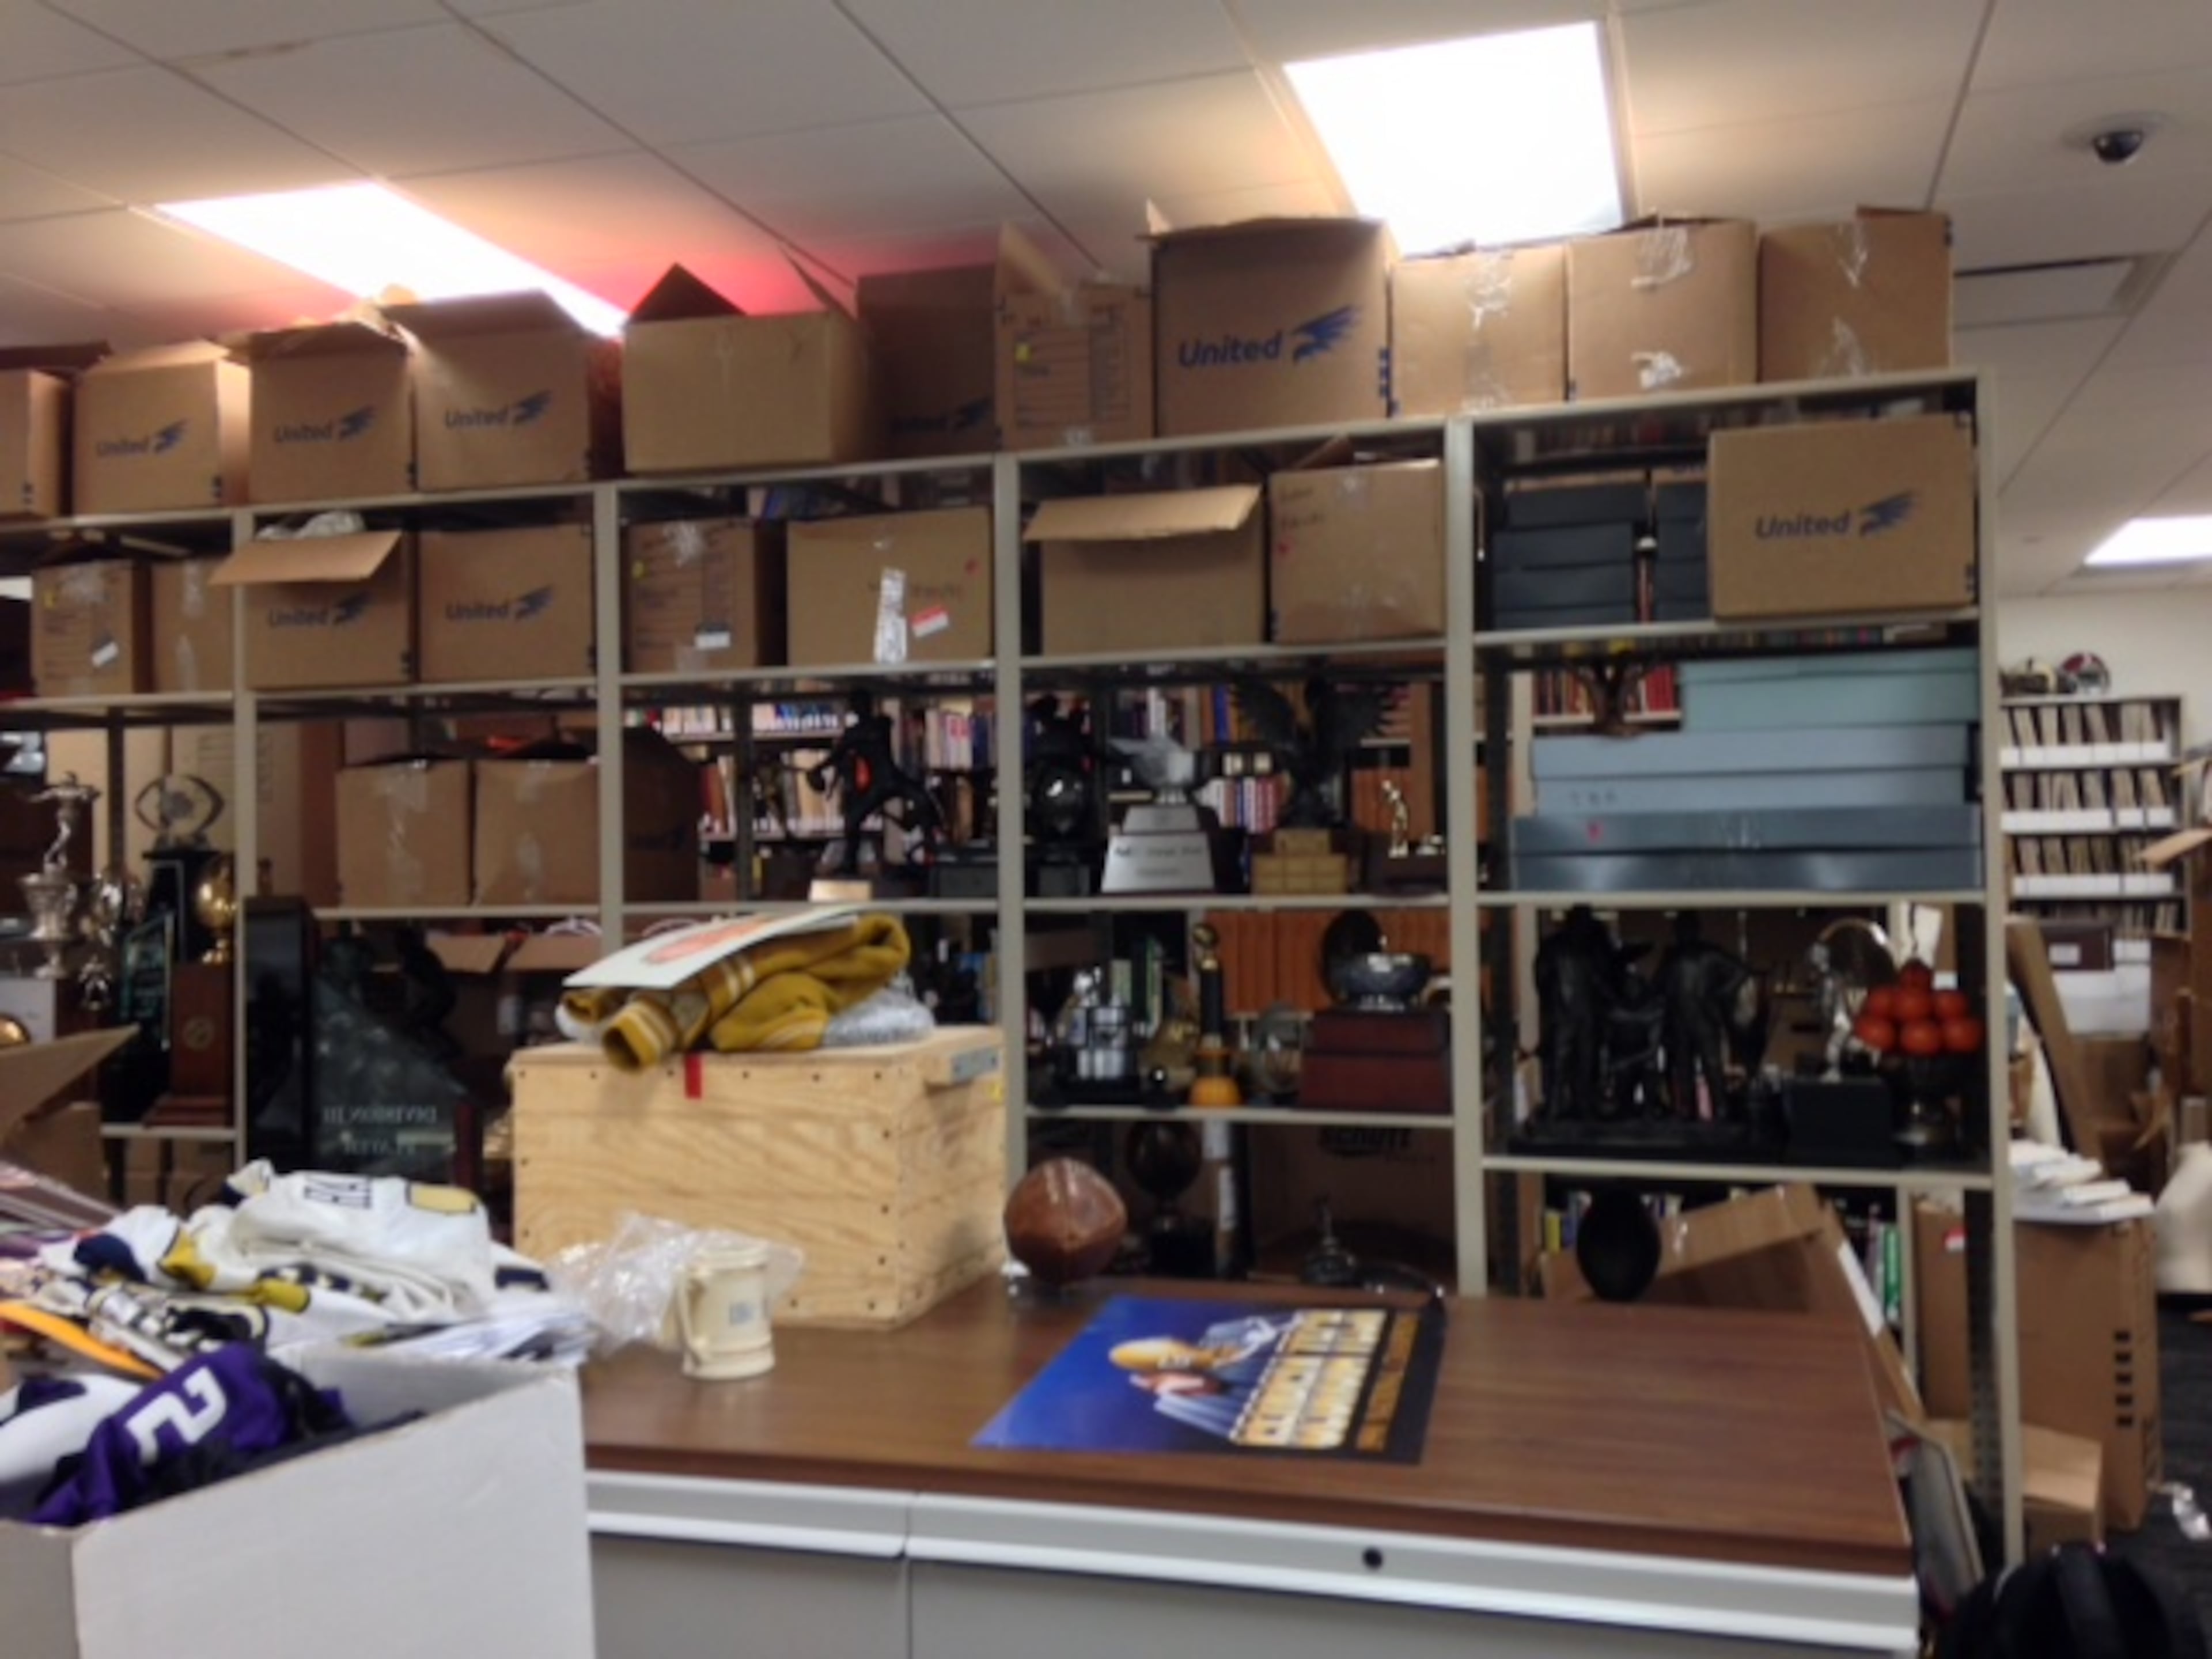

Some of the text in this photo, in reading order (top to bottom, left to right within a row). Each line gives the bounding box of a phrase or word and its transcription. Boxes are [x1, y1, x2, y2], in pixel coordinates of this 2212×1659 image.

[1178, 329, 1282, 368] United
[445, 405, 509, 428] United
[275, 421, 333, 445] United
[1755, 510, 1850, 539] United
[268, 609, 327, 629] United
[445, 601, 509, 622] United
[126, 1366, 227, 1463] 2
